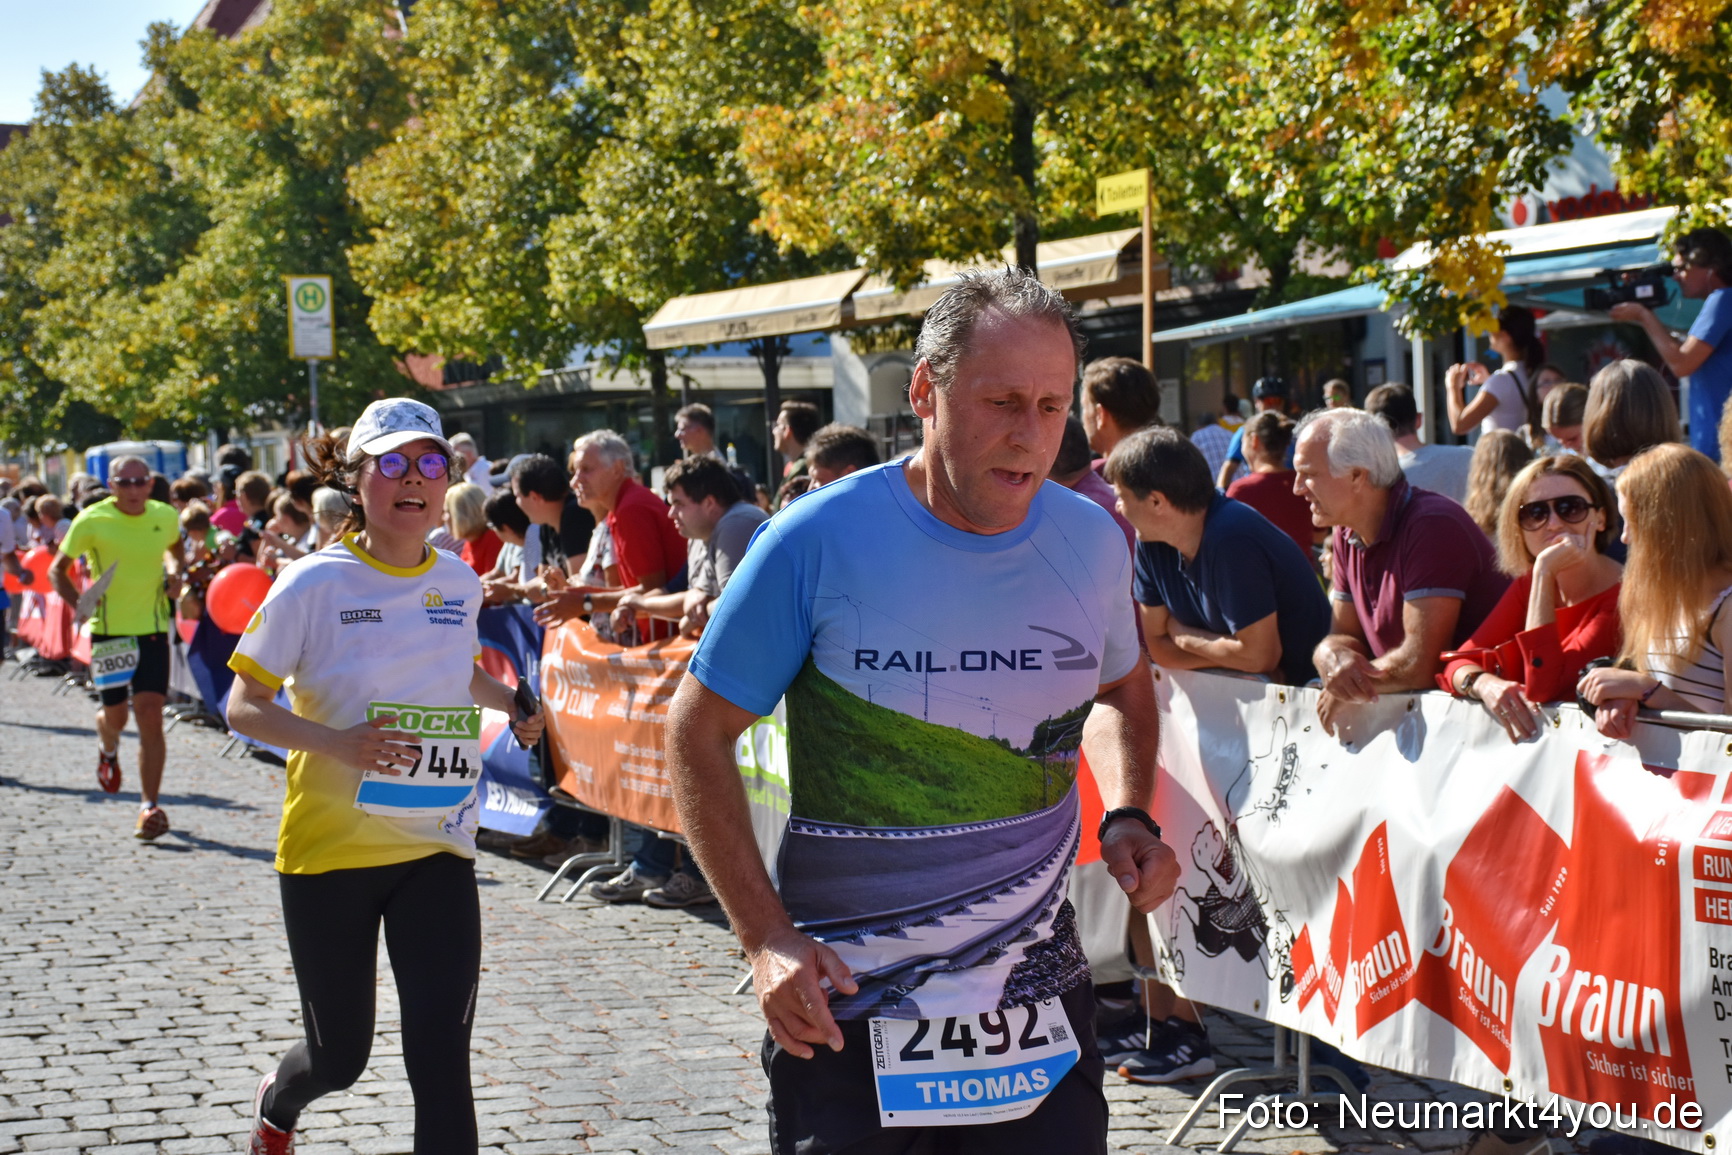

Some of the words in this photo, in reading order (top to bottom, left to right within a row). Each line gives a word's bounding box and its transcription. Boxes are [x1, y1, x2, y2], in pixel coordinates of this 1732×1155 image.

[303, 290, 317, 305] H
[342, 610, 381, 620] BOCK
[425, 593, 443, 607] 20
[96, 653, 136, 673] 2800
[854, 649, 1042, 672] RAIL.ONE
[379, 744, 469, 779] 744
[1539, 895, 1556, 917] Seit
[1552, 866, 1568, 894] 1929
[1352, 930, 1407, 1005] Braun
[1425, 897, 1508, 1026] Braun
[1458, 986, 1480, 1018] Sicher
[1480, 1010, 1491, 1029] ist
[1535, 943, 1672, 1058] Braun
[899, 1002, 1050, 1062] 2492
[1719, 1038, 1732, 1058] T
[915, 1068, 1050, 1104] THOMAS
[1586, 1050, 1626, 1079] Sicher
[1630, 1061, 1649, 1083] ist
[1650, 1065, 1696, 1092] sicher
